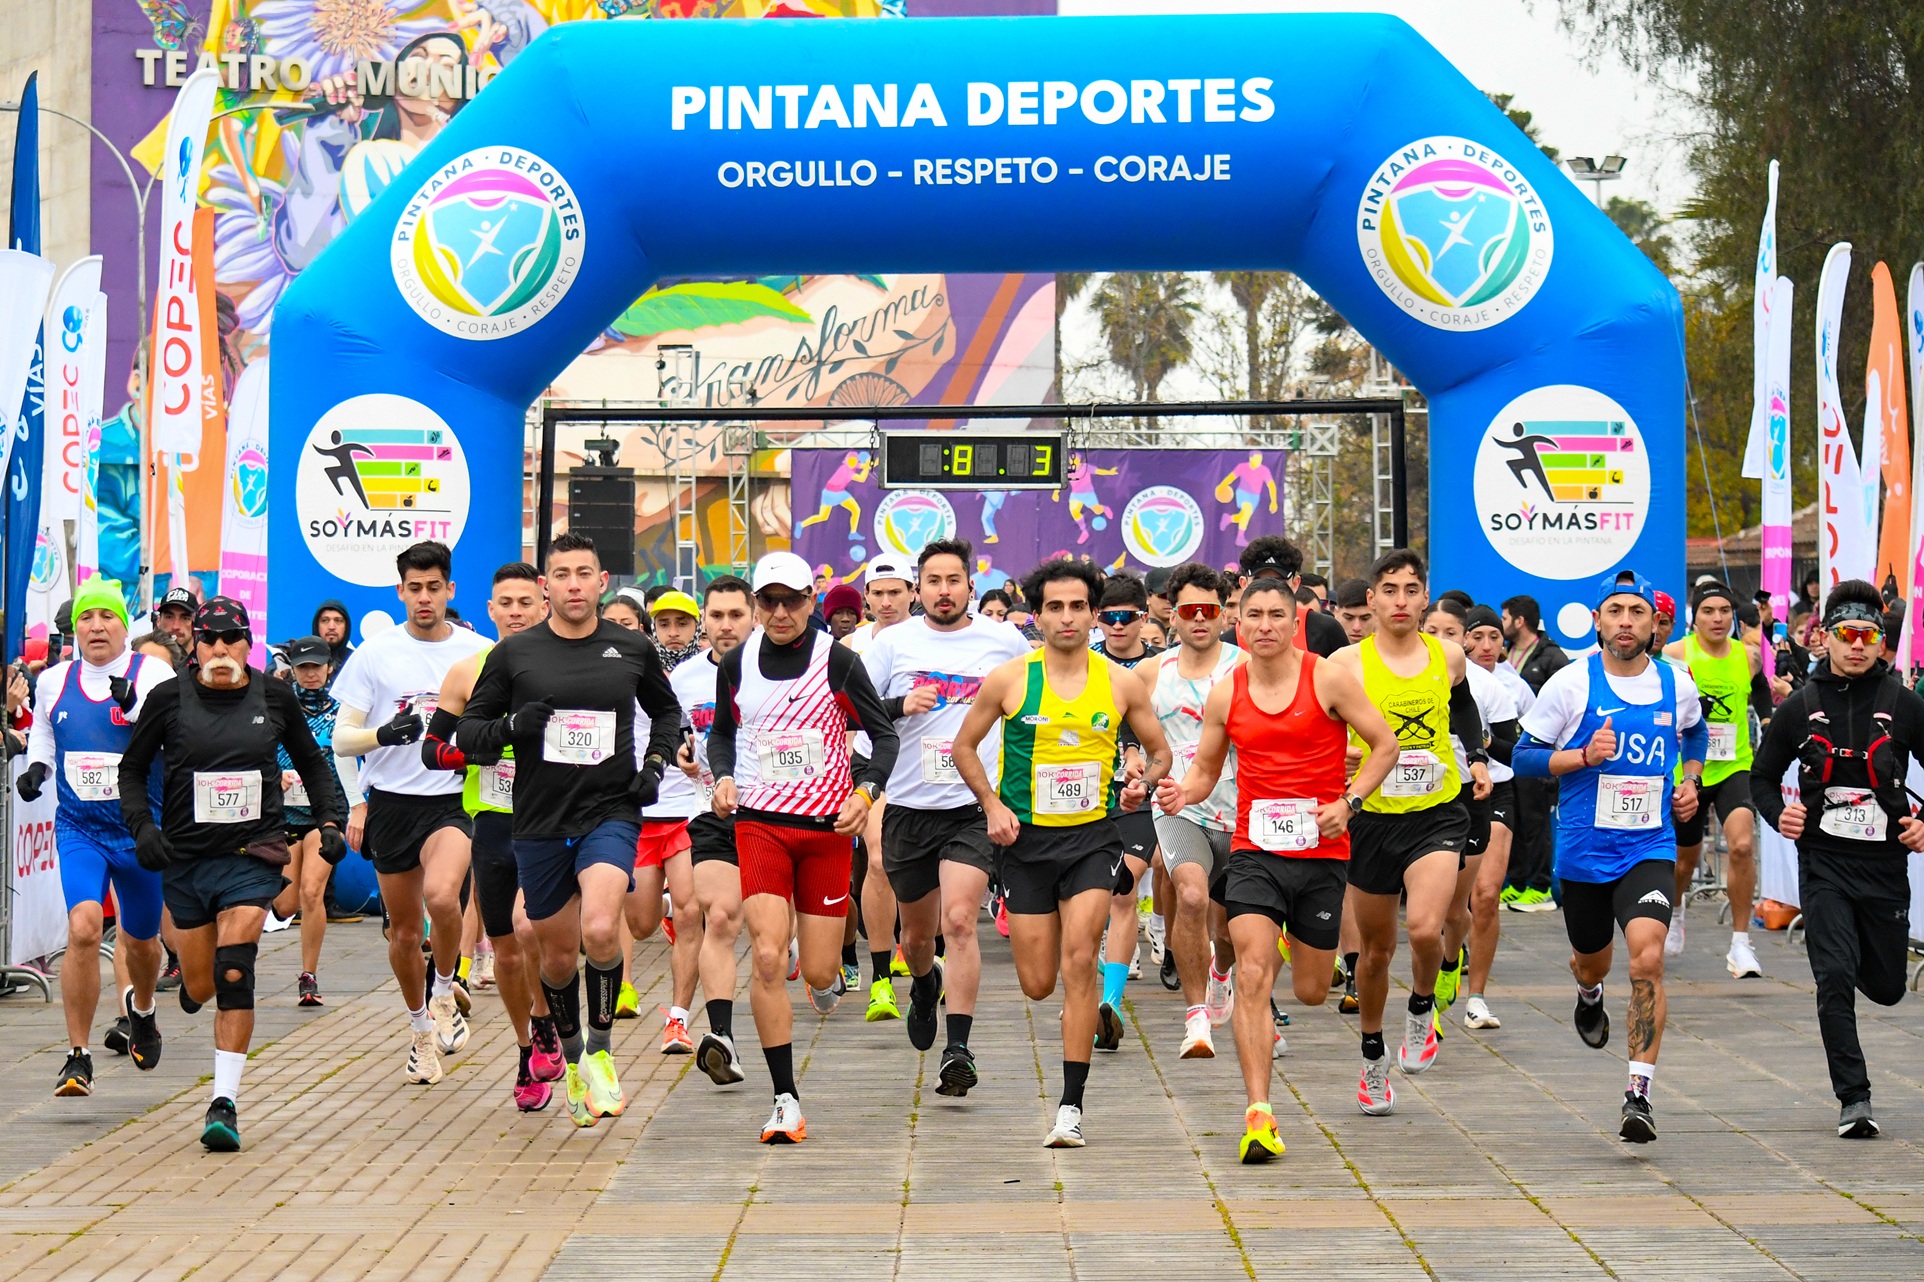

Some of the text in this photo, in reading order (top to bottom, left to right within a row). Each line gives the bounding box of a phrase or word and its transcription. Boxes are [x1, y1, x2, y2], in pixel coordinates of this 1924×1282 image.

[135, 49, 312, 92] TEATRO
[671, 77, 1275, 131] PINTANA DEPORTES
[718, 159, 877, 188] ORGULLO
[913, 156, 1058, 185] RESPETO
[1094, 153, 1231, 183] CORAJE
[1362, 143, 1546, 233] PINTANA DEPORTES
[398, 151, 579, 241] PINTANA DEPORTES
[1366, 248, 1546, 325] ORGULLO CORAJE RESPETO
[397, 256, 576, 334] ORGULLO CORAJE RESPETO
[163, 220, 195, 416] COPEC
[203, 373, 219, 420] VÍAS
[61, 363, 81, 494] COPEC
[363, 544, 374, 552] EN
[377, 544, 386, 552] LA
[1548, 537, 1560, 545] EN
[1563, 537, 1573, 545] LA
[1576, 537, 1612, 545] PINTANA
[1389, 698, 1427, 708] CARABINEROS
[567, 716, 596, 727] CORRIDA
[568, 731, 592, 747] 320
[774, 735, 803, 746] CORRIDA
[1604, 731, 1666, 767] USA
[779, 750, 803, 765] 035
[82, 771, 102, 785] 582
[1403, 768, 1426, 782] 537
[215, 779, 243, 789] CORRIDA
[1057, 783, 1081, 797] 489
[1601, 782, 1618, 790] 10K
[218, 792, 239, 806] 577
[1621, 797, 1643, 812] 517
[1268, 804, 1297, 816] CORRIDA
[1845, 807, 1866, 823] 313
[1271, 819, 1294, 833] 146
[1316, 910, 1332, 921] NB
